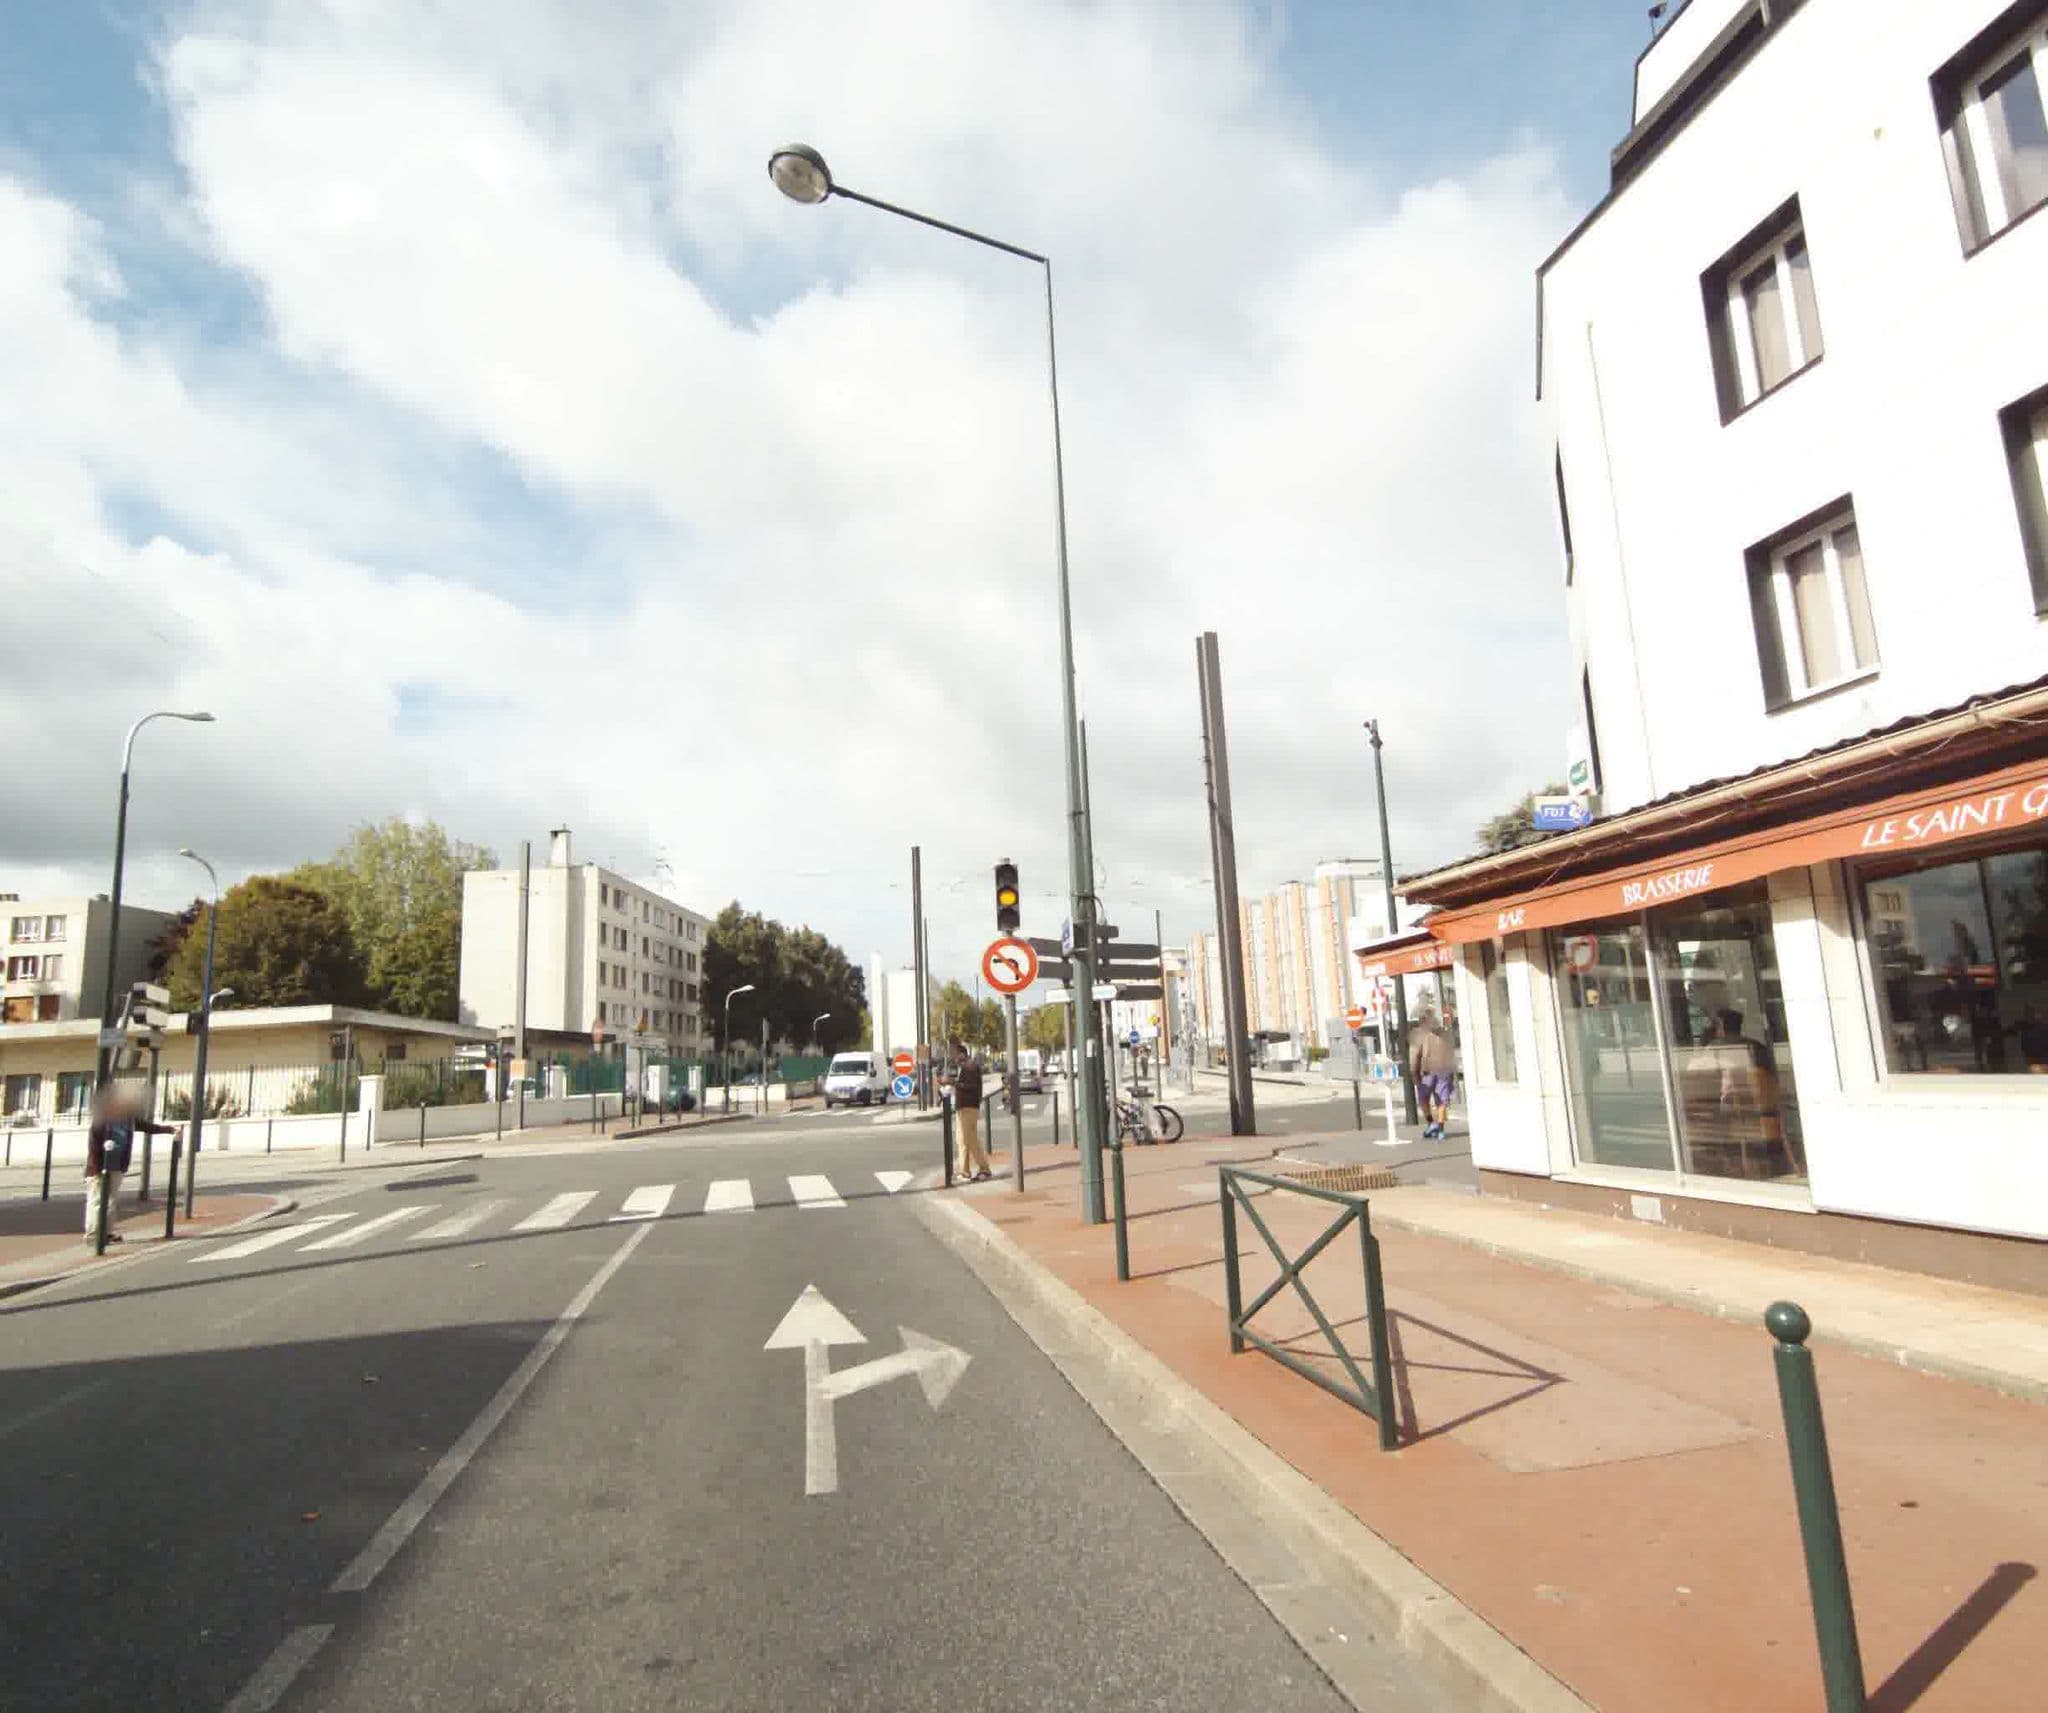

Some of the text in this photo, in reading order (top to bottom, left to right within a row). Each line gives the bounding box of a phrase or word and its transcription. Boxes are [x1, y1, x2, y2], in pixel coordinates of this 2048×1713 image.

[1861, 819, 1898, 848] LE
[1903, 791, 2016, 841] SAINT
[1622, 864, 1714, 907] BRASSERIE
[1497, 908, 1527, 930] BAR
